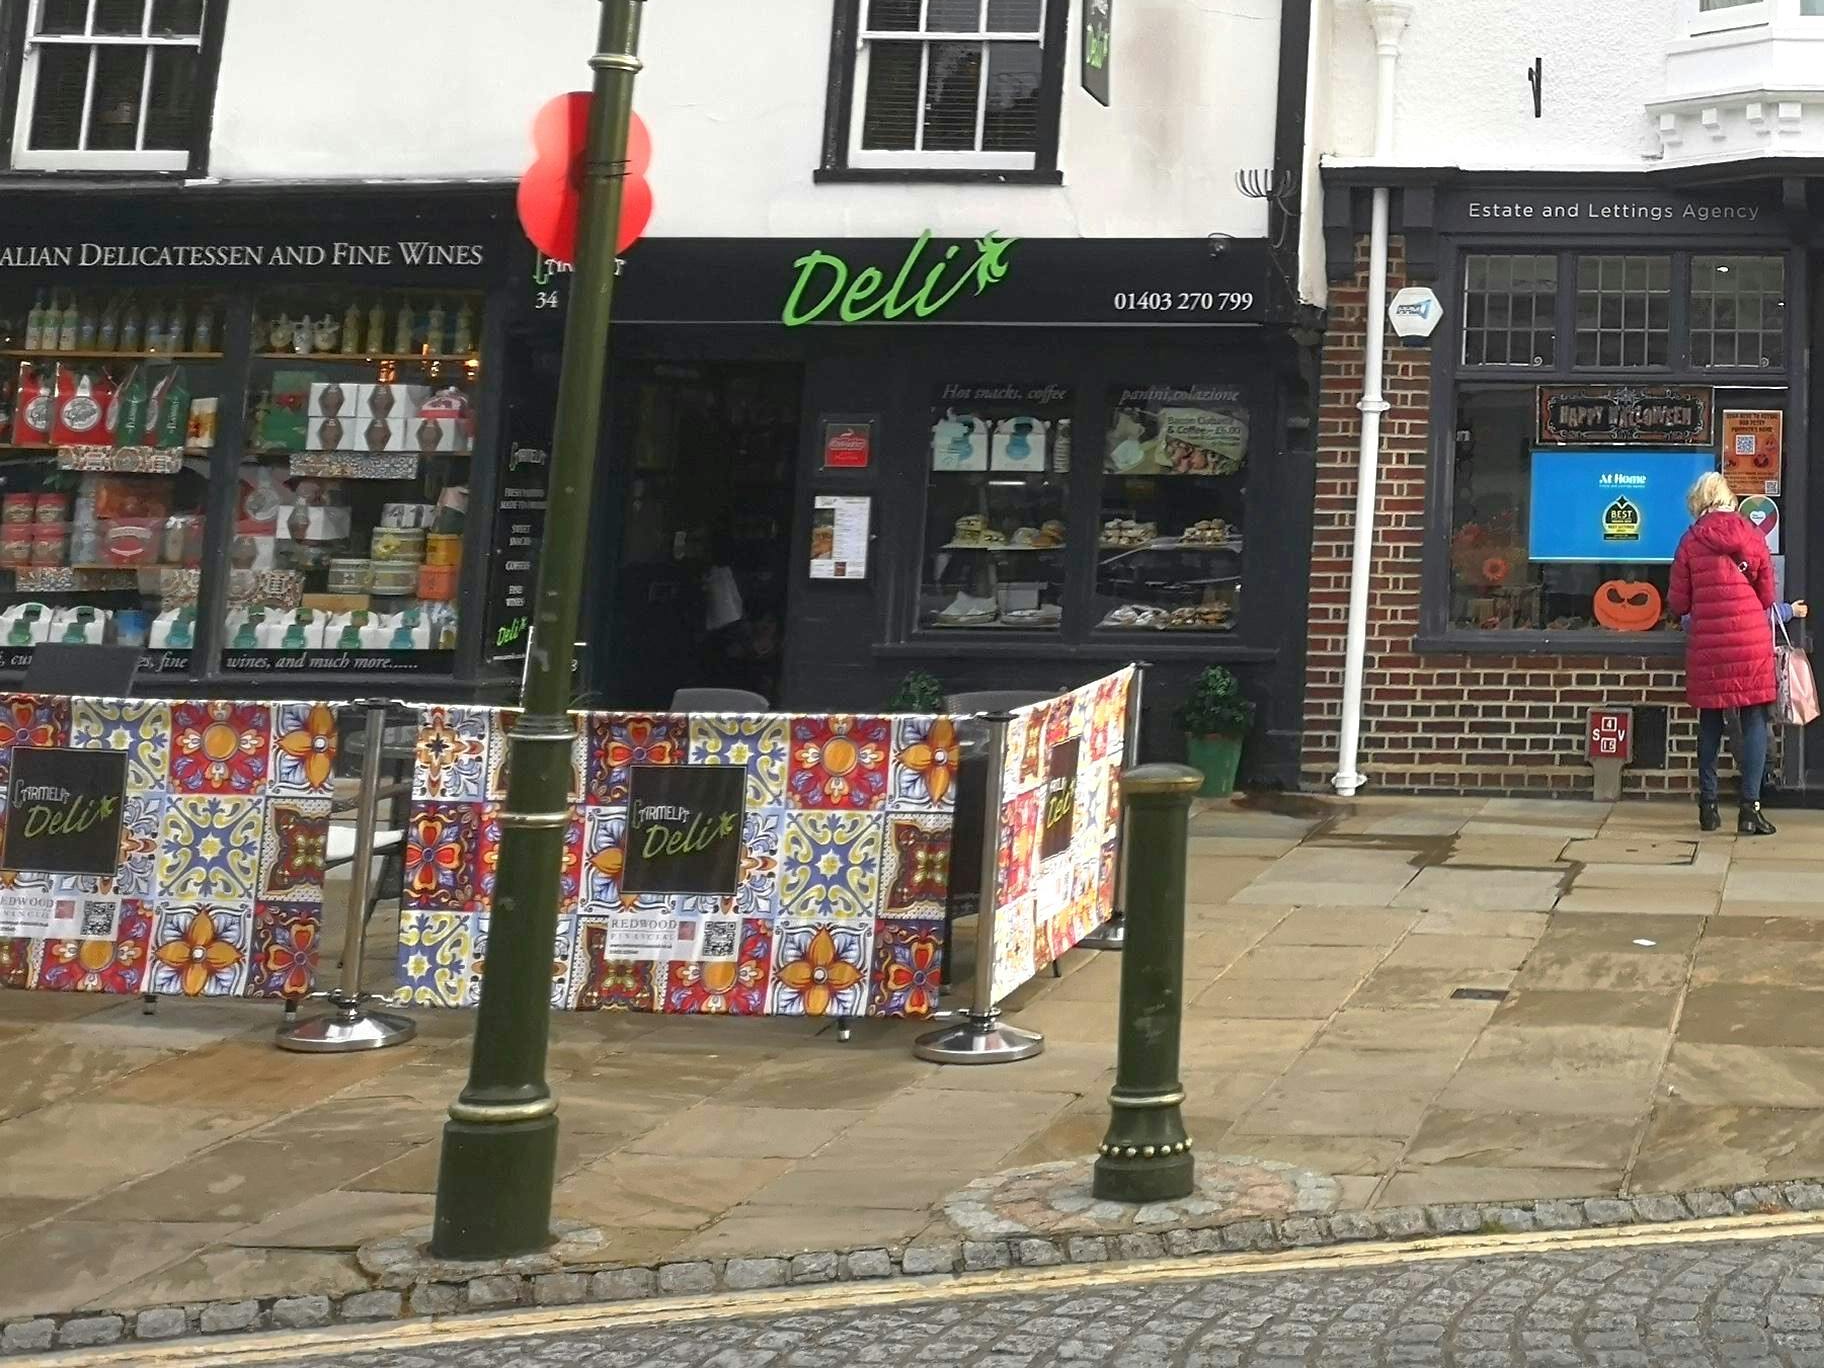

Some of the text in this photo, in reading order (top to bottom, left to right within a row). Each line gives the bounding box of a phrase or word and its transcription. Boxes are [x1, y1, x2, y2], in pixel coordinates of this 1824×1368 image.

[1468, 202, 1760, 221] Estate and Lettings Agency
[268, 246, 326, 266] AND
[782, 228, 985, 327] Deli
[535, 290, 559, 310] 34
[1114, 291, 1255, 312] 01403 270 799
[1559, 403, 1693, 429] HAPPY HALLOWEEN
[1598, 473, 1647, 484] At Home
[1610, 510, 1633, 520] BEST
[155, 650, 189, 673] fine
[226, 652, 271, 669] wines,
[275, 651, 306, 669] and
[309, 652, 352, 669] much
[1606, 719, 1613, 729] 4
[1591, 728, 1626, 742] S V
[24, 794, 100, 839] Deli
[642, 812, 721, 859] Deli
[611, 918, 678, 930] REDWOOD
